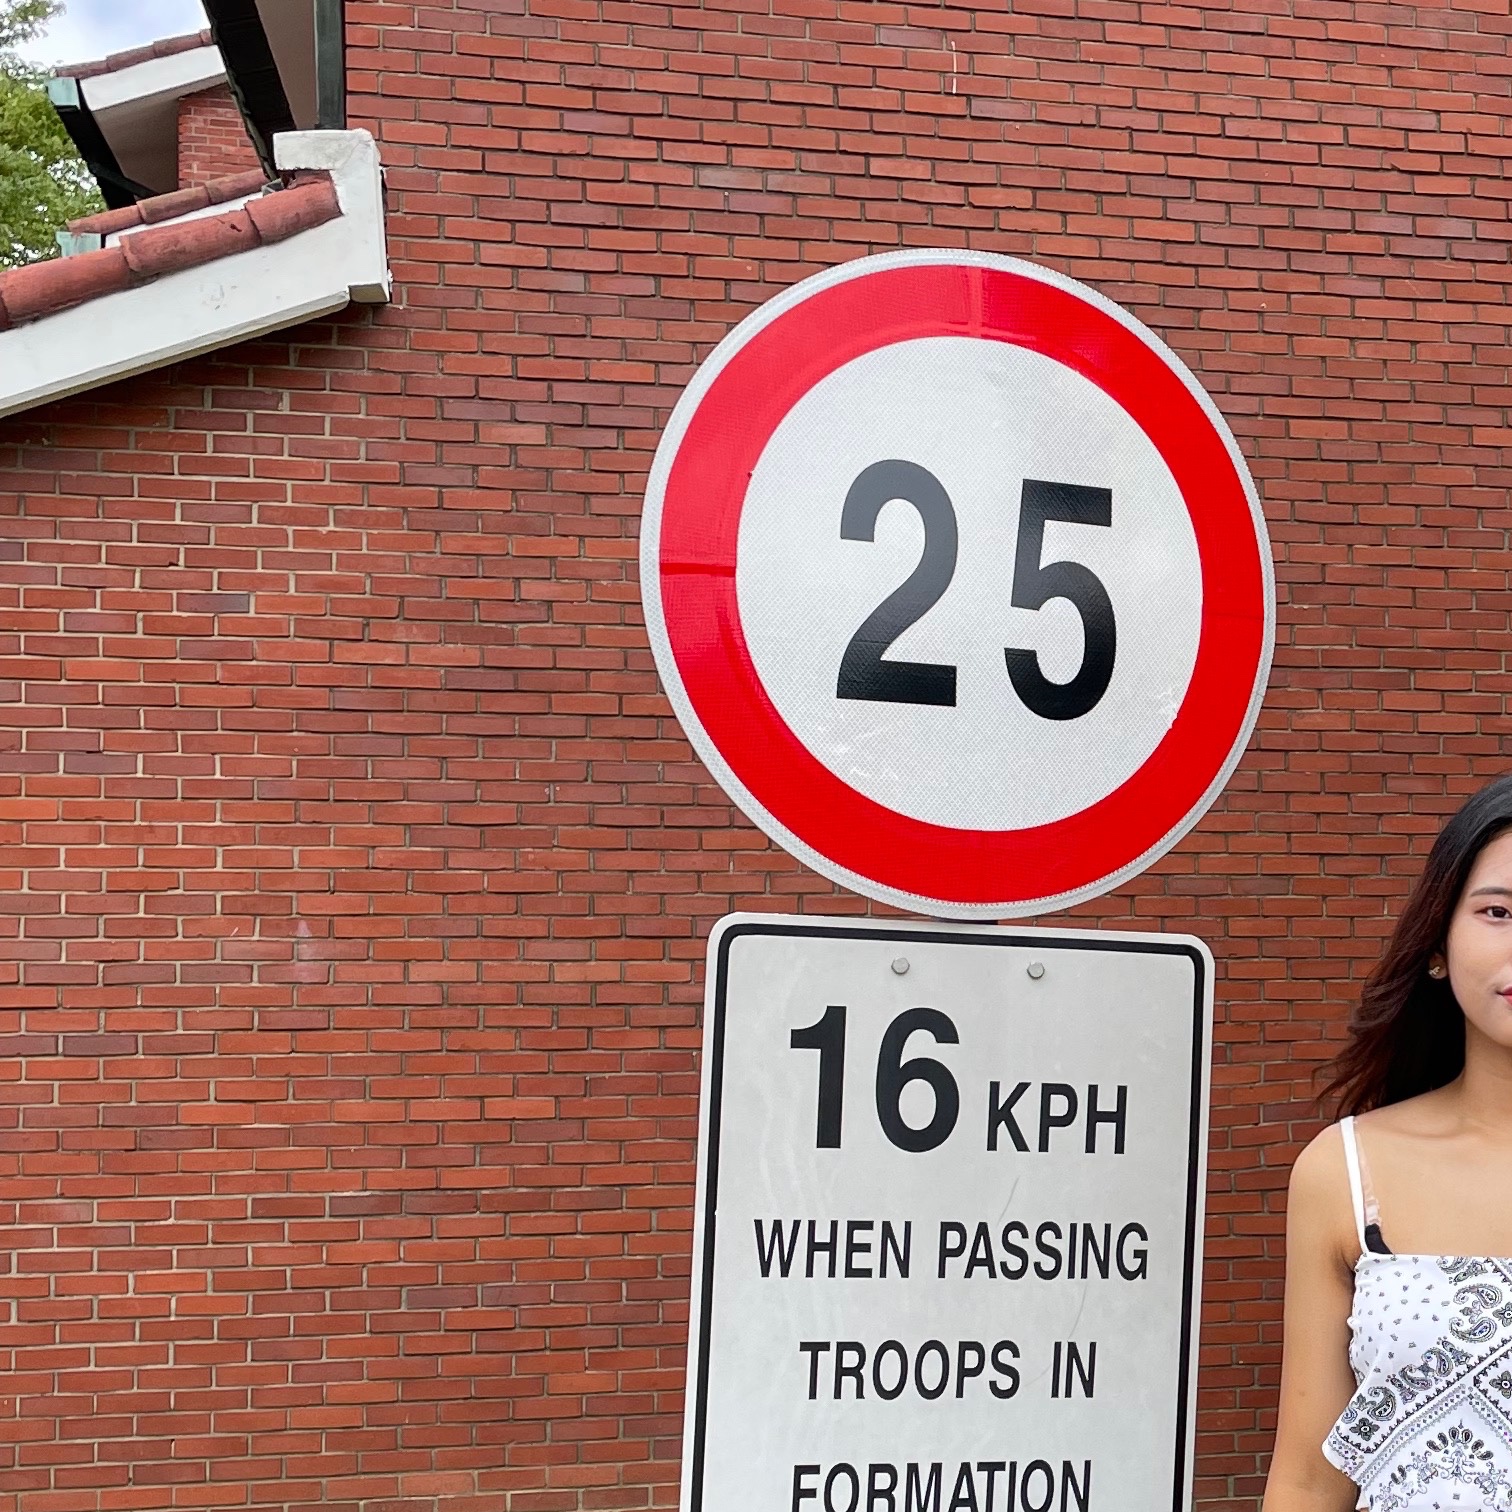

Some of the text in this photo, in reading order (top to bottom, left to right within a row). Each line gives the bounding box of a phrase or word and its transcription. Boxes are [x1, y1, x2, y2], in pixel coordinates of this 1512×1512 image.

[836, 459, 1117, 721] 25
[790, 1005, 1128, 1155] 16 KPH
[753, 1218, 1149, 1282] WHEN PASSING
[799, 1339, 1097, 1401] TROOPS IN
